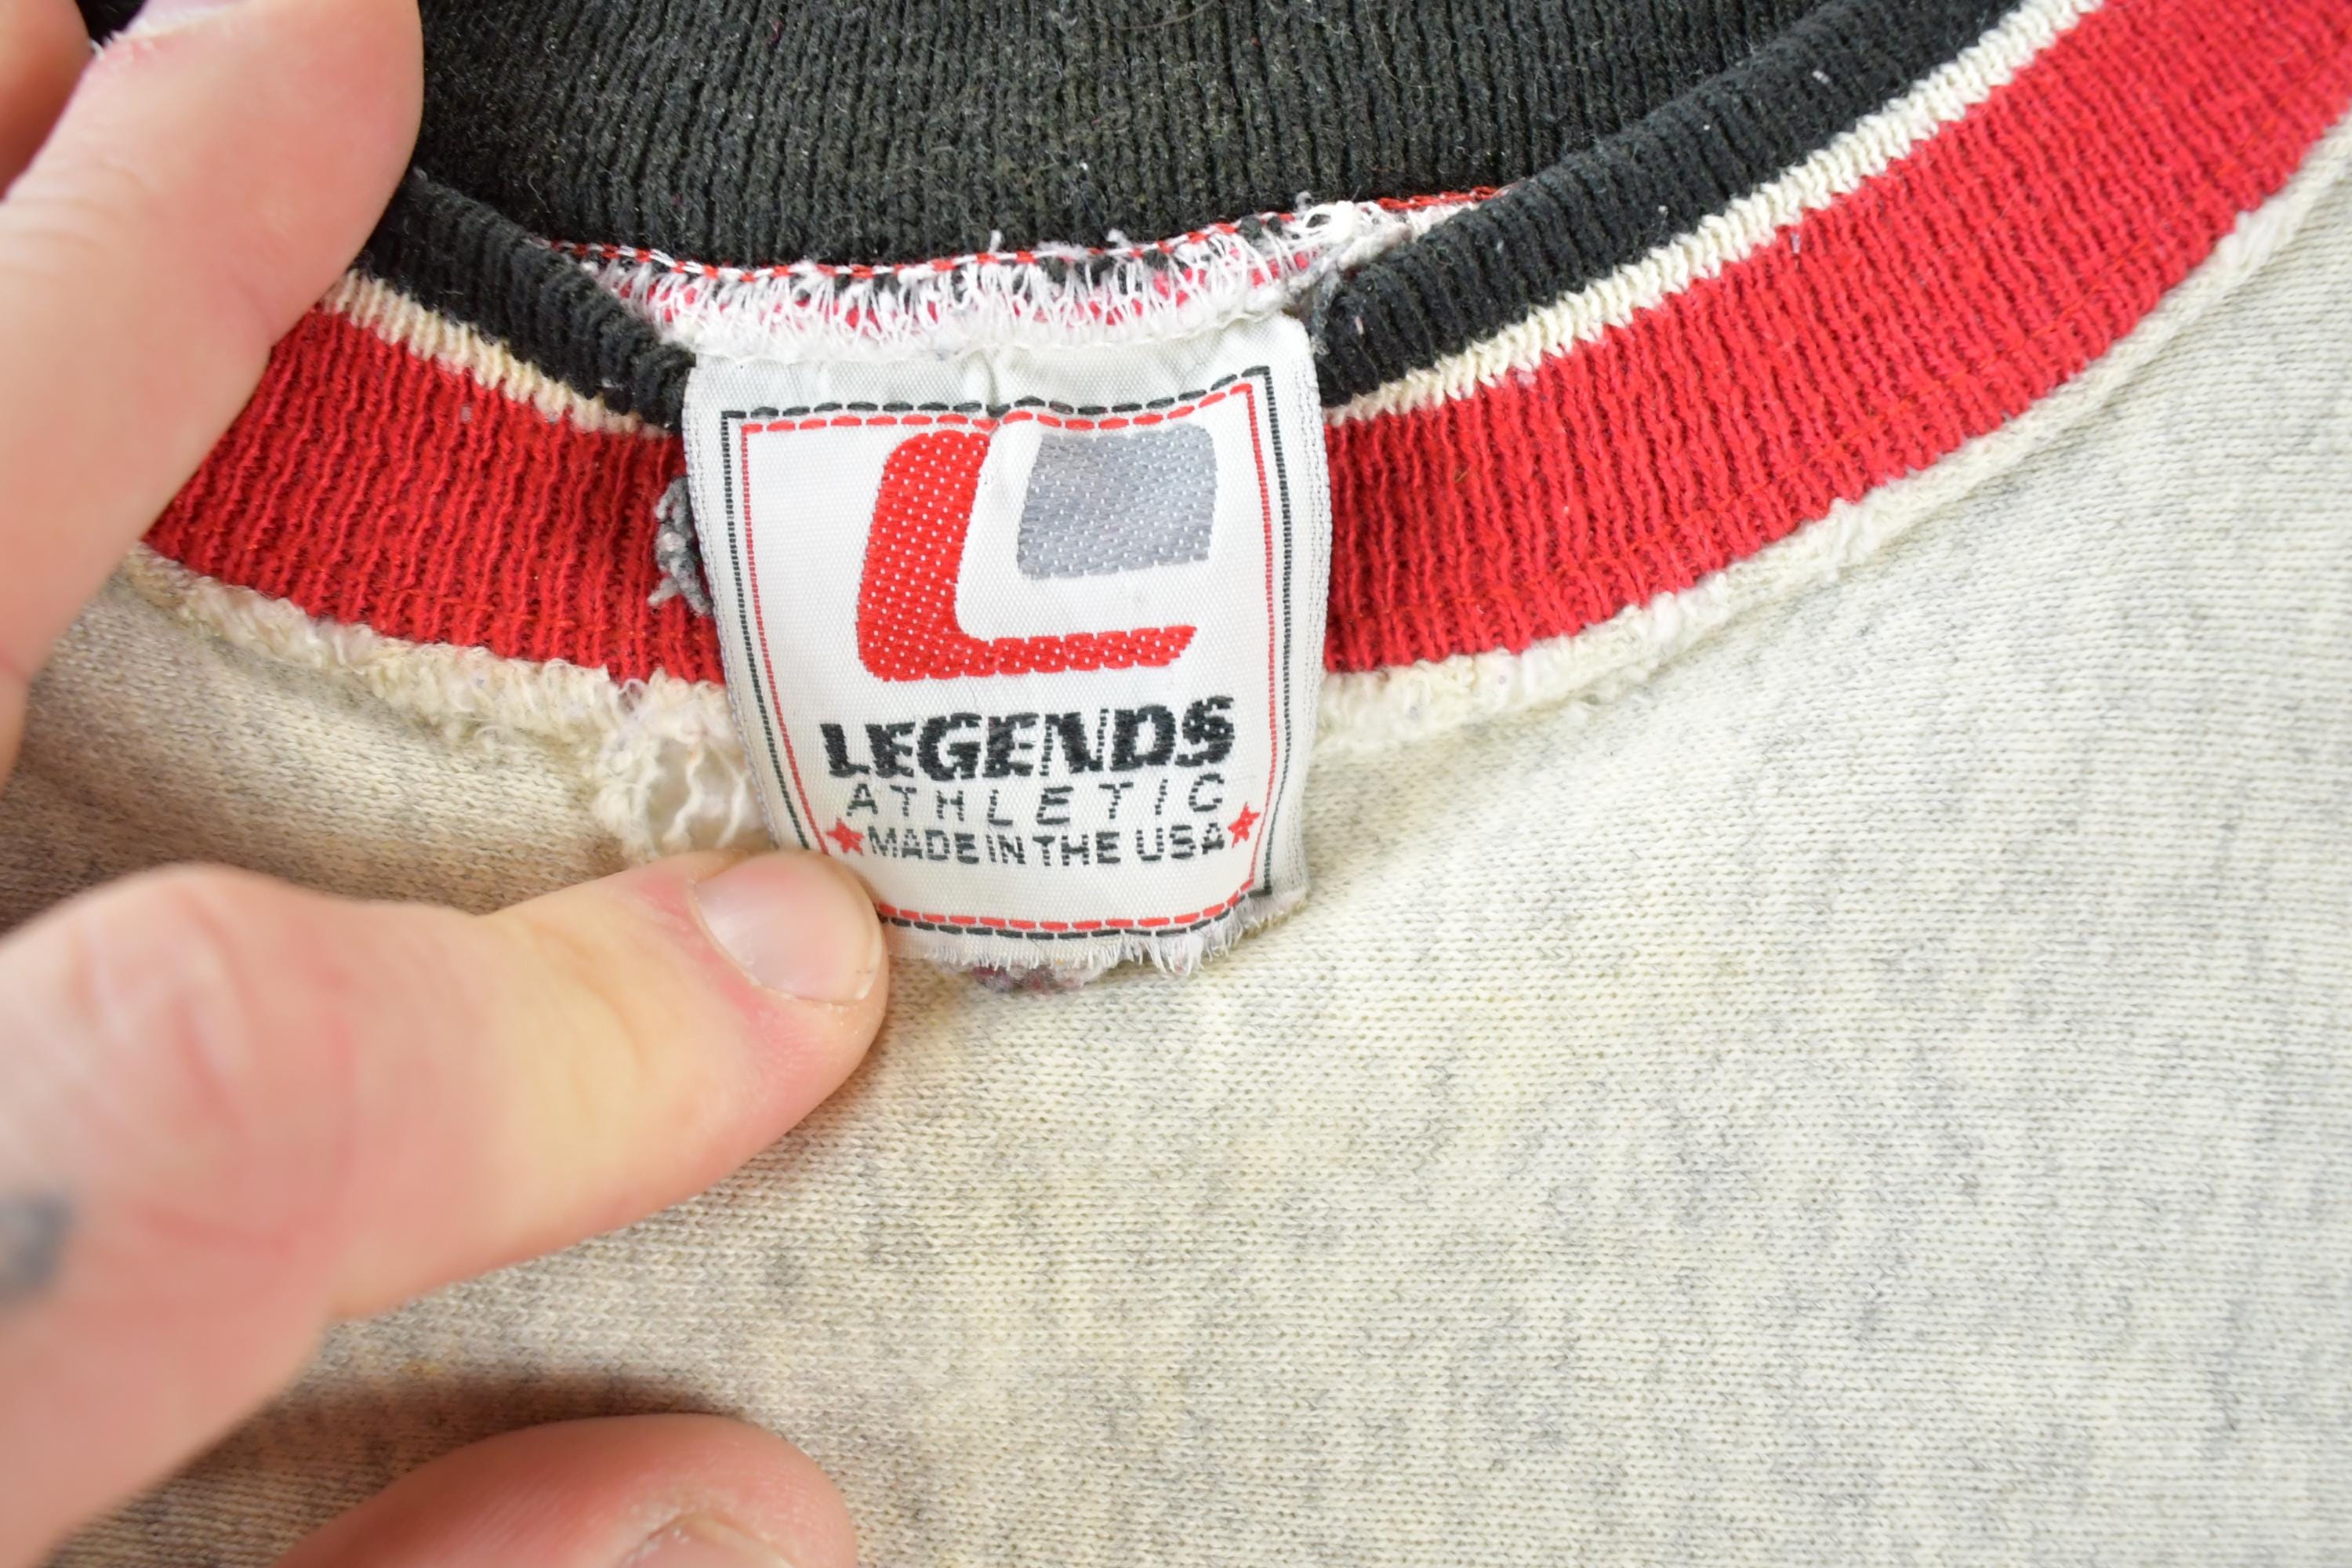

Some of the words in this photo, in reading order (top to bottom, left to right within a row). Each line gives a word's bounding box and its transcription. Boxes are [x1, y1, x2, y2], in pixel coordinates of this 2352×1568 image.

[820, 695, 1235, 781] LEGENDS
[846, 773, 1225, 826] ATHLETIC
[867, 826, 980, 864] MADE
[985, 834, 1024, 865] IN
[1032, 831, 1121, 866] THE
[1135, 822, 1225, 862] USA
